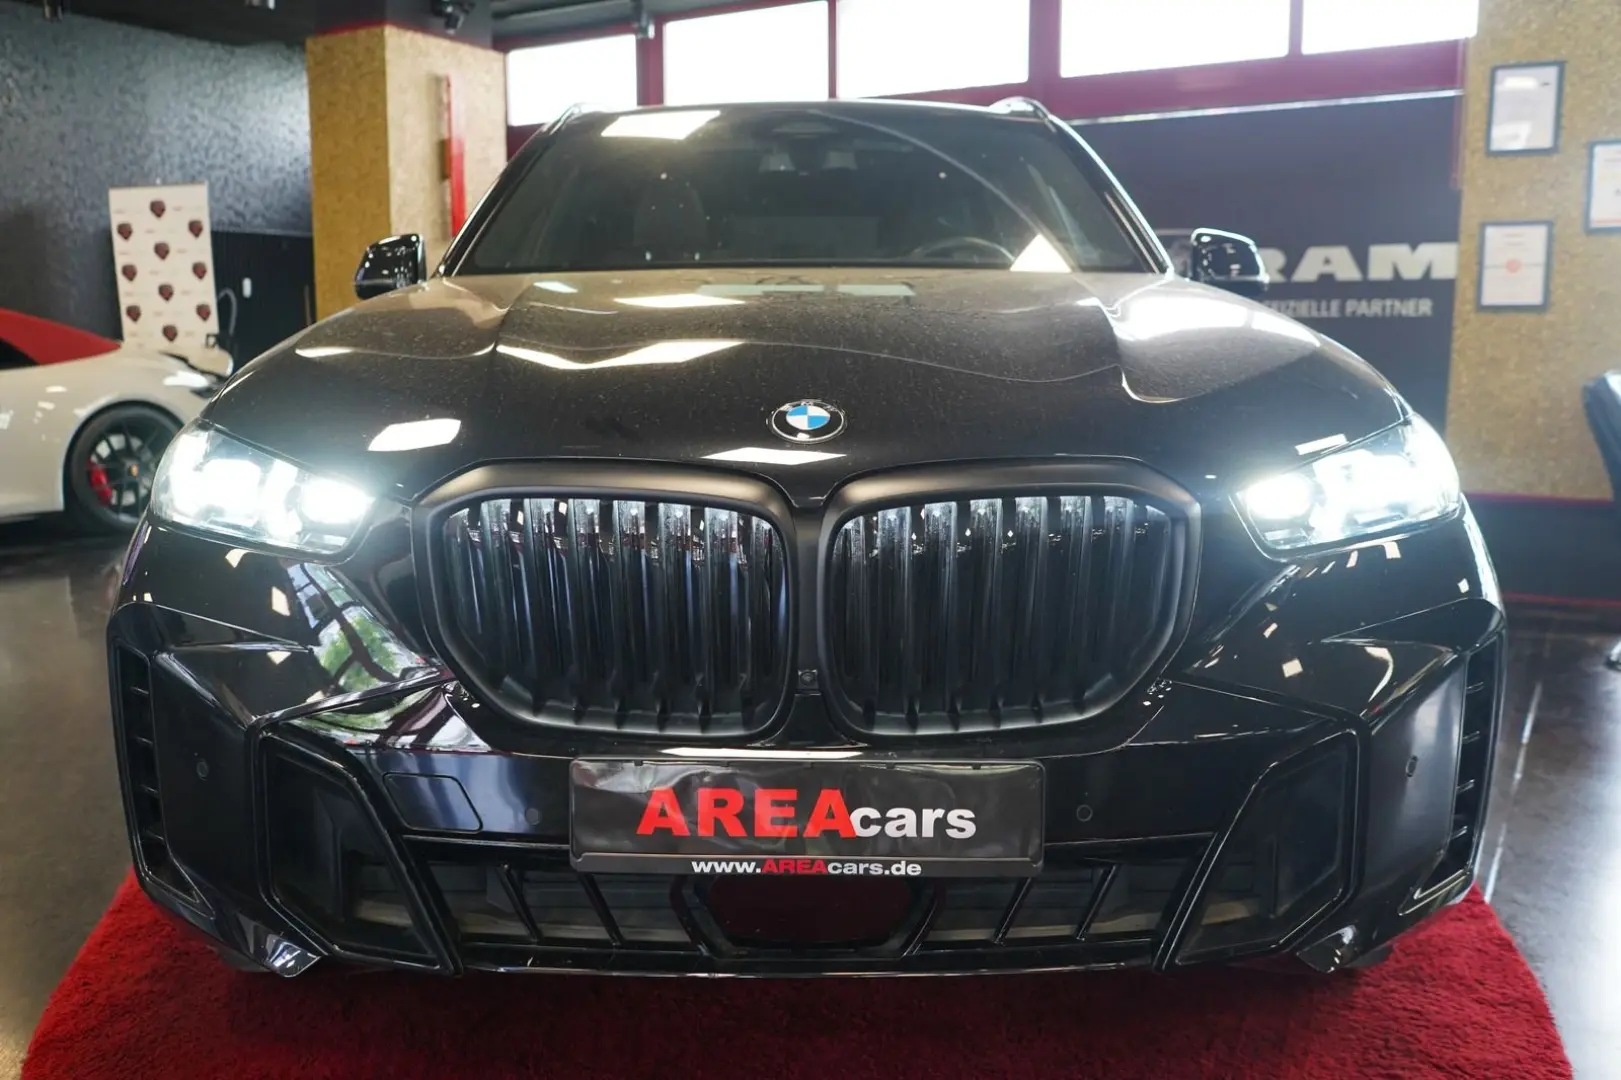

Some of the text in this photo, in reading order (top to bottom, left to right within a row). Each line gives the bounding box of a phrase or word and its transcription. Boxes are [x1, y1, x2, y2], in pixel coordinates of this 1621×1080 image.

[1346, 298, 1432, 317] PARTNER
[636, 787, 976, 839] AREAcars
[691, 858, 922, 876] www.AREAcars.de
